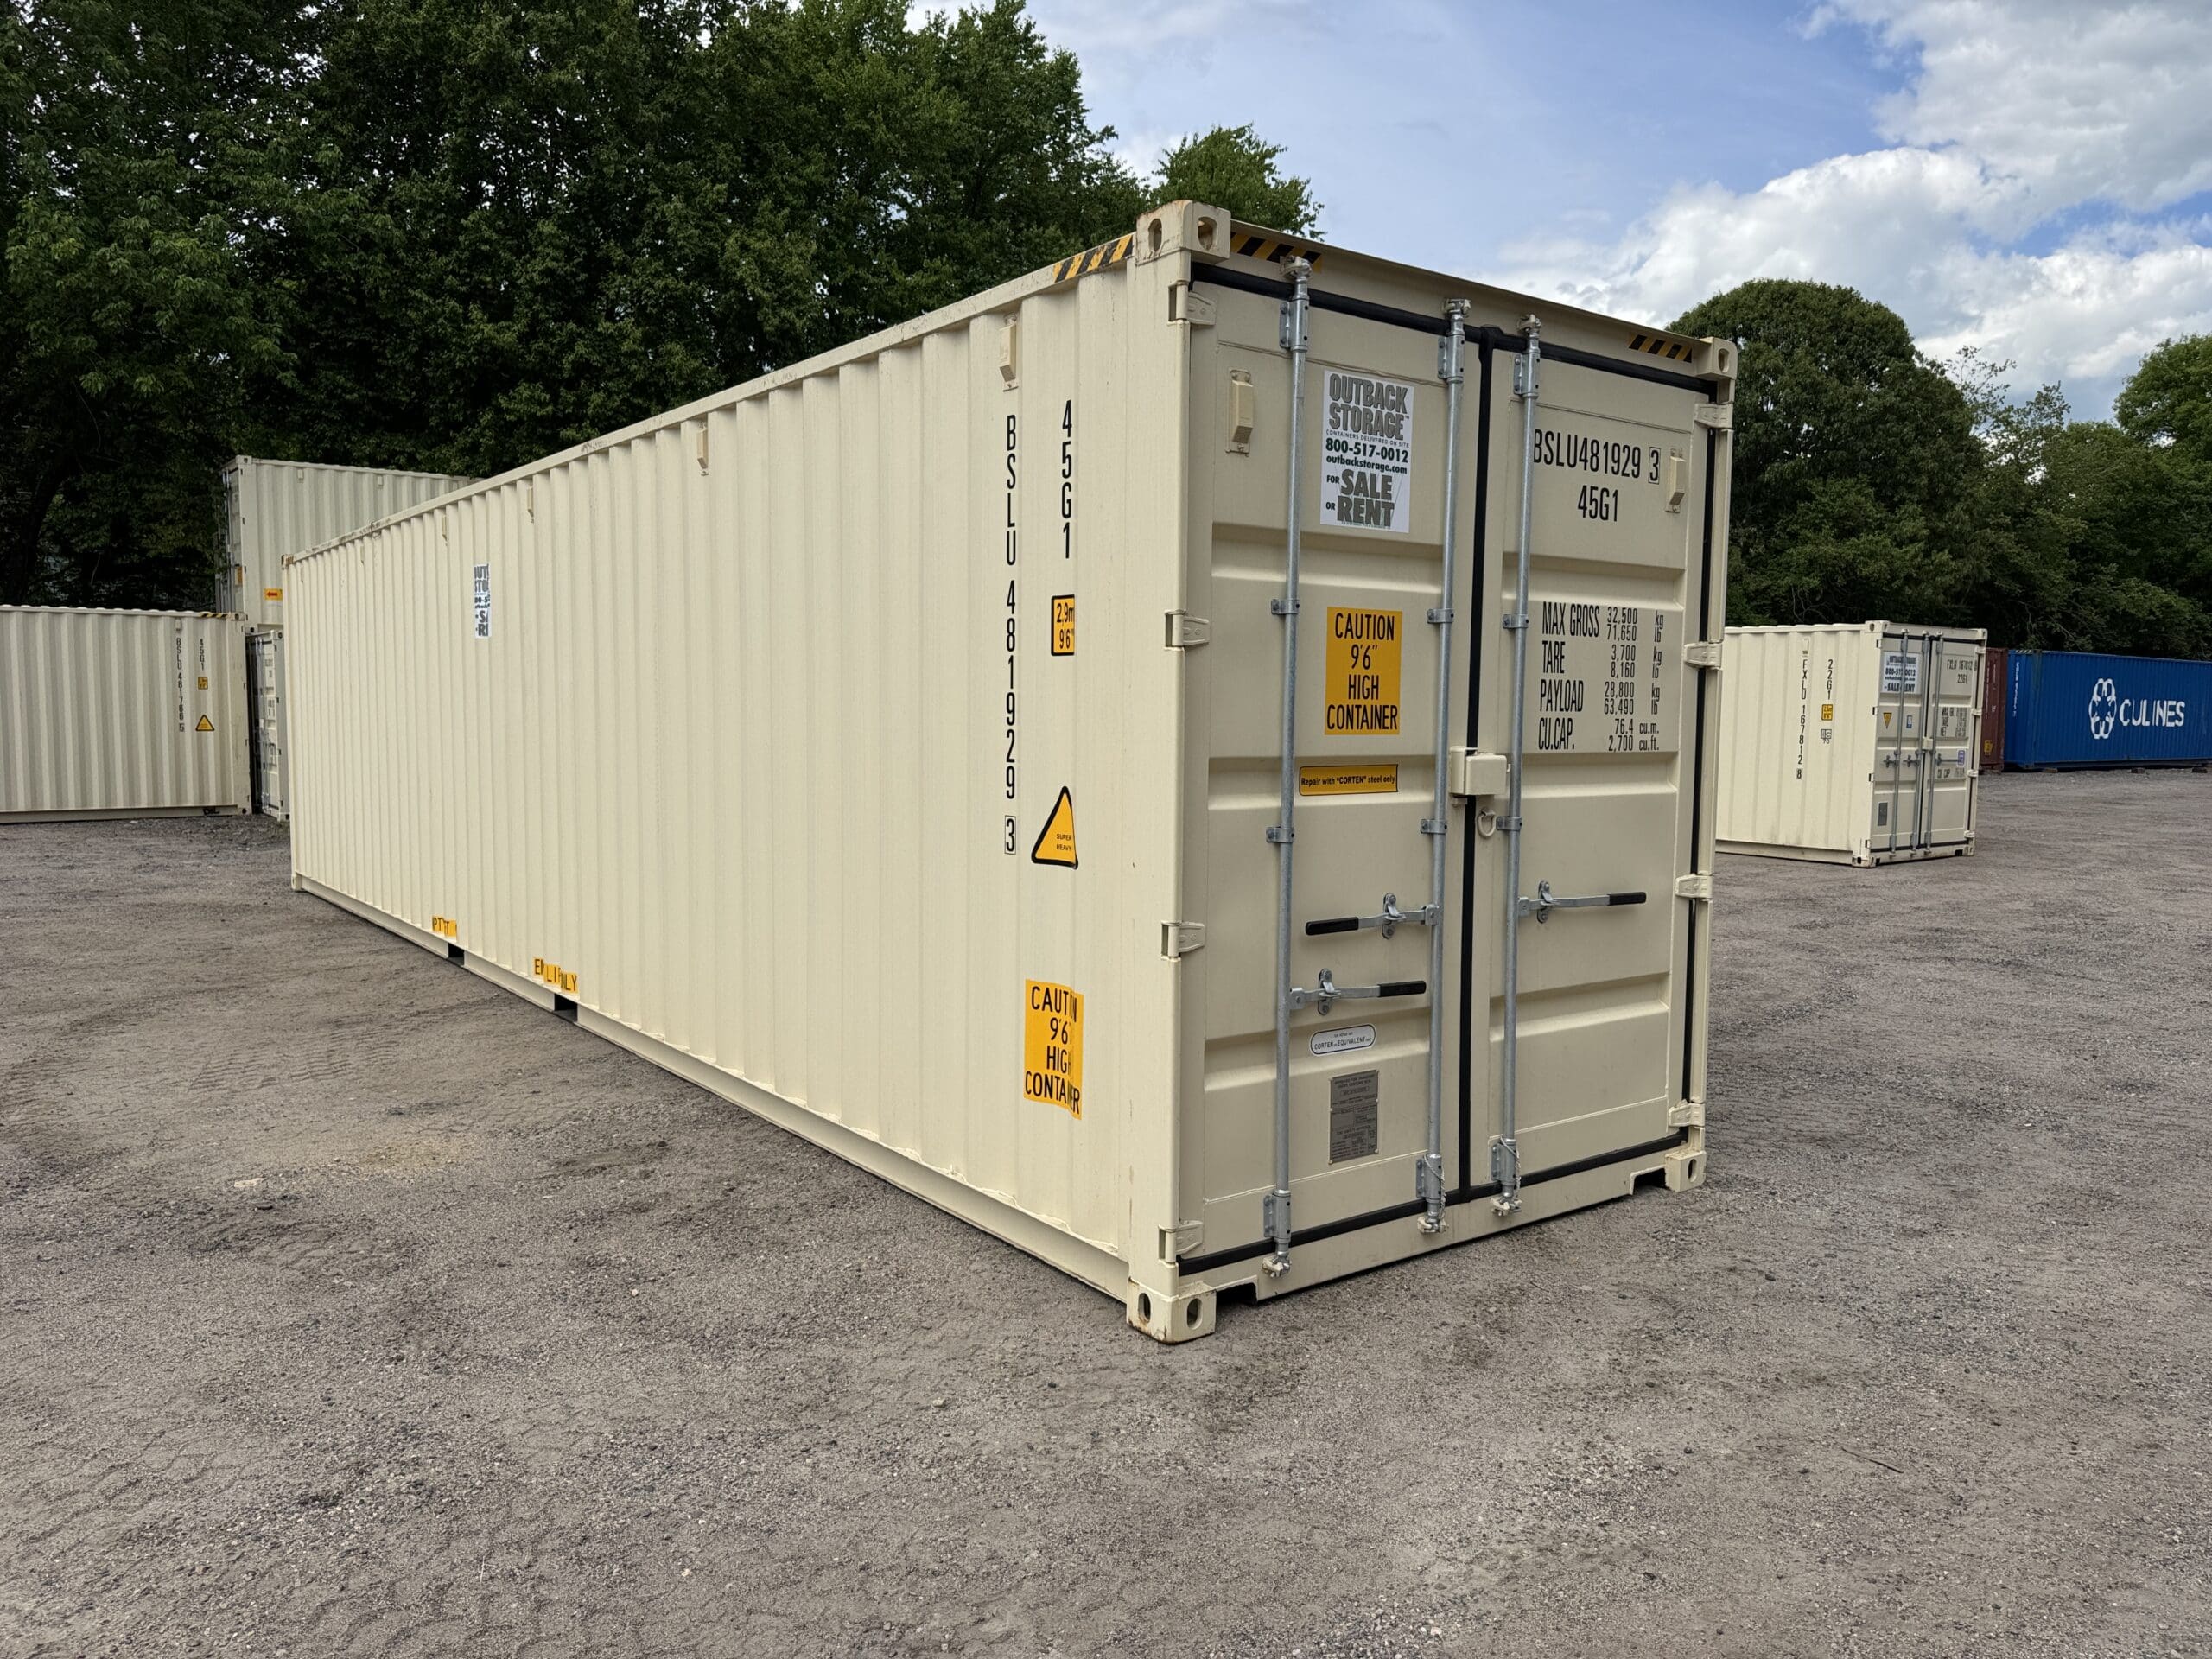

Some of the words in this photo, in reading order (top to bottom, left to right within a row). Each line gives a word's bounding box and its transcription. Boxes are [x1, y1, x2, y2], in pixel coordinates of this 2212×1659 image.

[1329, 372, 1408, 414] OUTBACK
[1328, 402, 1404, 441] STORAGE
[1325, 437, 1408, 463] 800-517-0012
[1326, 429, 1358, 440] CONTAINERS
[1361, 435, 1388, 445] DELIVERED
[1326, 454, 1408, 474] outbackstorage.com
[1649, 449, 1659, 481] 3
[1007, 415, 1016, 566] BSLU
[1061, 399, 1072, 559] 45G1
[1326, 475, 1339, 485] FOR
[1340, 468, 1393, 500] SALE
[1325, 501, 1336, 511] OR
[1337, 495, 1395, 527] RENT
[1578, 485, 1618, 522] 45G1
[1335, 613, 1395, 641] CAUTION
[1542, 601, 1567, 636] MAX
[1569, 603, 1600, 638] GROSS
[1606, 607, 1637, 625] 32,500
[1655, 610, 1664, 630] kg
[1606, 624, 1637, 642] 71,650
[1654, 626, 1662, 643] lb
[1351, 644, 1378, 671] 9'6"
[1541, 640, 1566, 674] TARE
[1611, 644, 1636, 662] 3,700
[1653, 646, 1662, 666] kg
[1611, 662, 1636, 679] 8,160
[1652, 663, 1660, 679] lb
[1006, 579, 1015, 799] 481929
[1348, 674, 1379, 700] HIGH
[1540, 679, 1584, 712] PAYLOAD
[1605, 681, 1635, 699] 28,800
[1651, 683, 1661, 702] kg
[1327, 704, 1398, 731] CONTAINER
[1604, 698, 1634, 715] 63,490
[1650, 699, 1658, 715] lb
[2120, 699, 2186, 728] CULINES
[1538, 717, 1575, 751] CU.CAP.
[1615, 718, 1634, 734] 76.4
[1638, 722, 1660, 734] cu.m.
[1608, 735, 1634, 753] 2,700
[1638, 735, 1660, 751] cu.ft.
[1301, 778, 1321, 787] Repair
[1368, 775, 1382, 784] steel
[1383, 775, 1395, 785] only
[1006, 818, 1015, 852] 3
[1056, 843, 1071, 852] HEAVY
[1314, 1041, 1334, 1050] CORTEN
